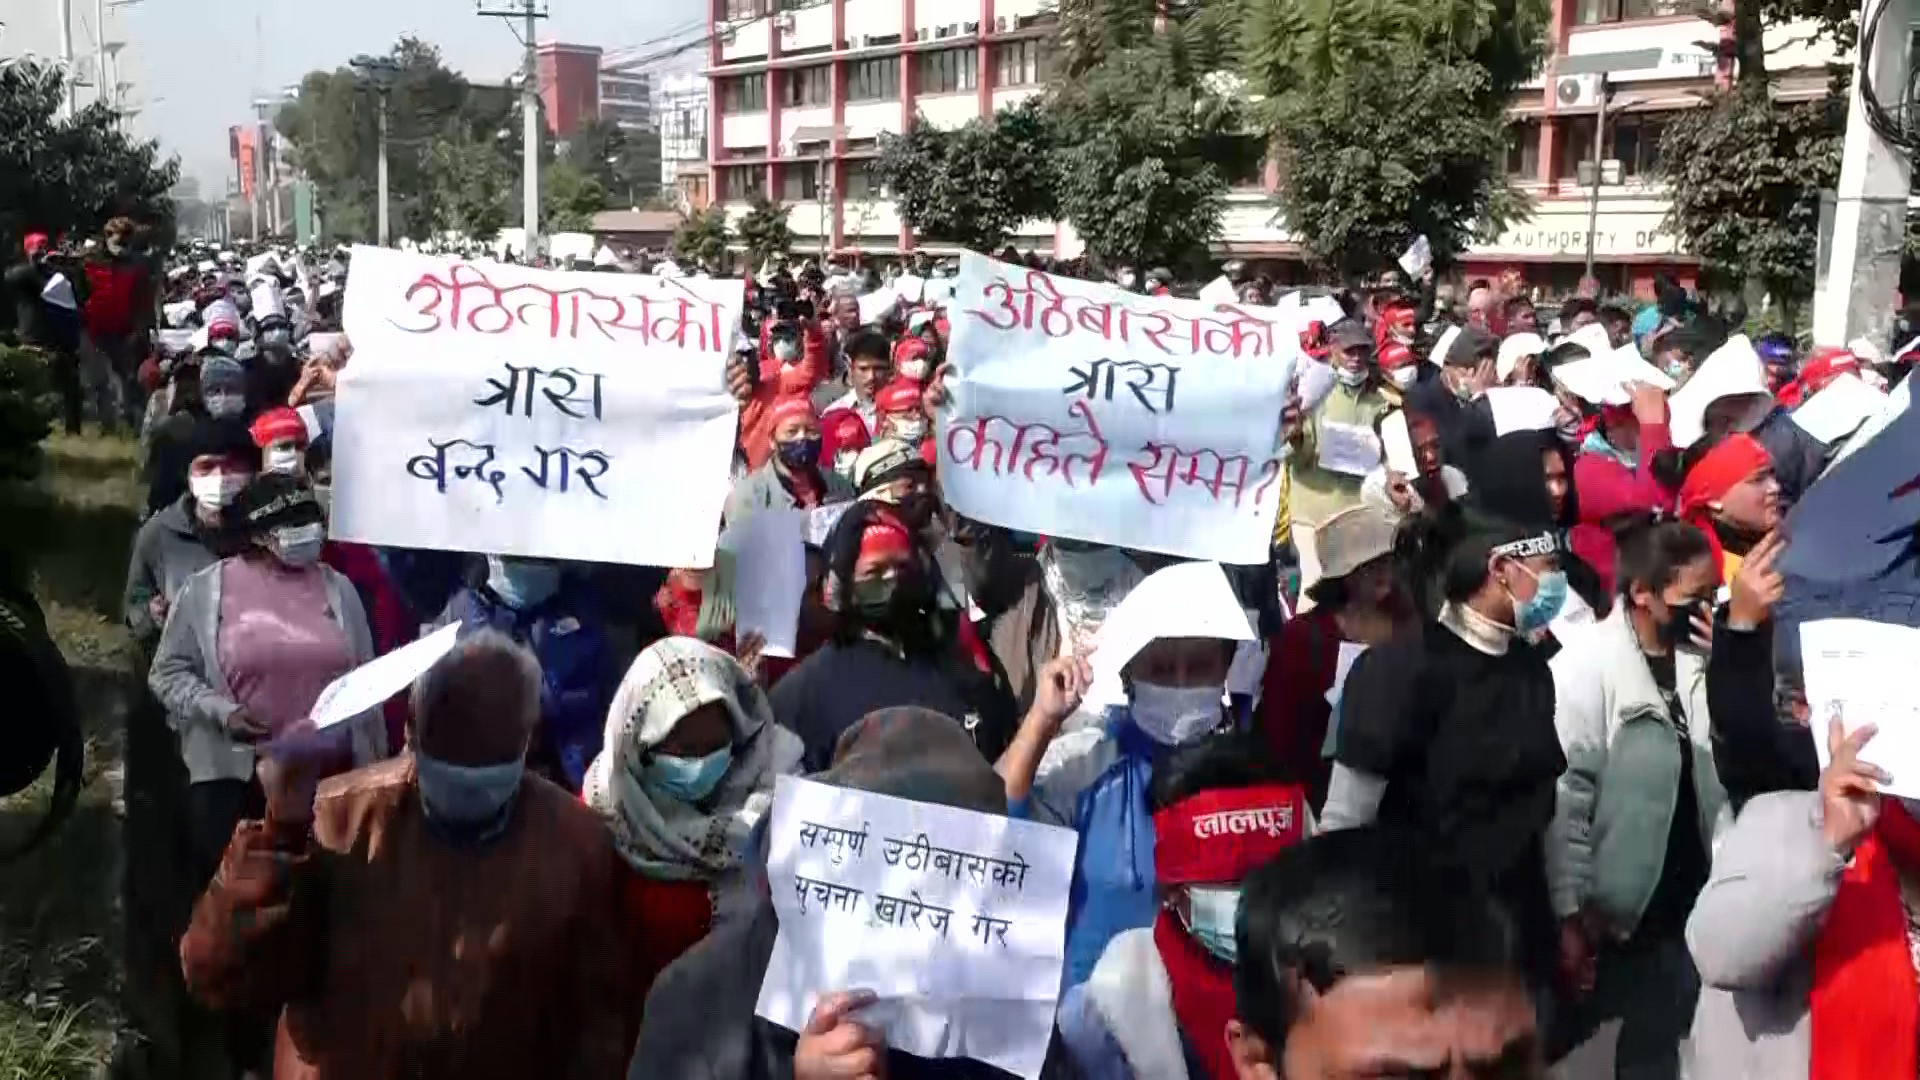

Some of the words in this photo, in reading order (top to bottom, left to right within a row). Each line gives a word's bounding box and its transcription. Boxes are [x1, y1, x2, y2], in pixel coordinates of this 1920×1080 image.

[963, 270, 1278, 359] उठिबासको
[473, 363, 605, 420] त्रास
[1062, 357, 1182, 414] त्रास
[520, 444, 615, 500] गर
[883, 833, 1031, 892] उठीबासको
[875, 888, 955, 942] खारेज
[972, 915, 1013, 948] गर
